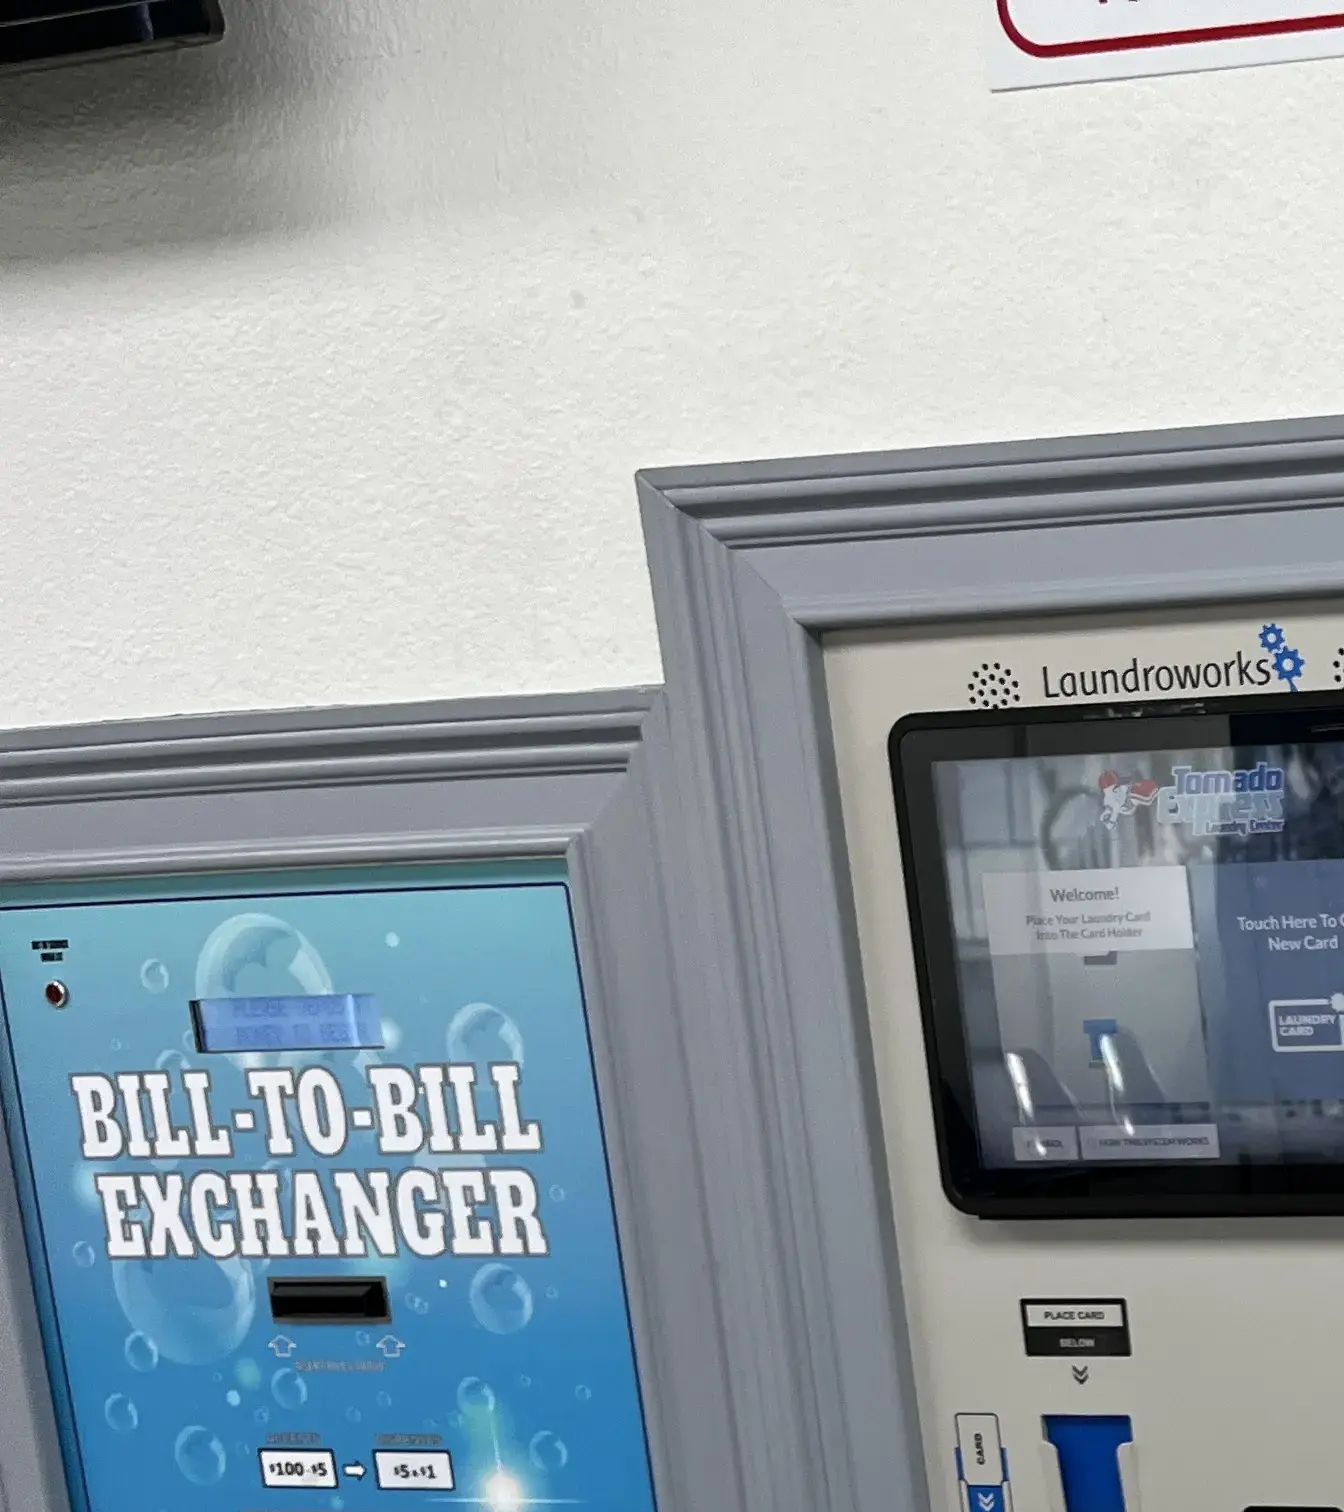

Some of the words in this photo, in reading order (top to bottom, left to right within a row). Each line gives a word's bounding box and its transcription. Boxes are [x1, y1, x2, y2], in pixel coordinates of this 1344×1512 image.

[1041, 650, 1271, 699] Laundroworks
[1237, 915, 1280, 930] Touch
[1282, 915, 1317, 930] Here
[1319, 913, 1337, 928] To
[1268, 937, 1301, 951] New
[1304, 935, 1338, 950] Card
[70, 1063, 542, 1159] BILL-TO-BILL
[95, 1168, 548, 1260] EXCHANGER
[1044, 1311, 1075, 1320] PLACE
[1078, 1311, 1105, 1320] CARD
[974, 1433, 986, 1465] CARD
